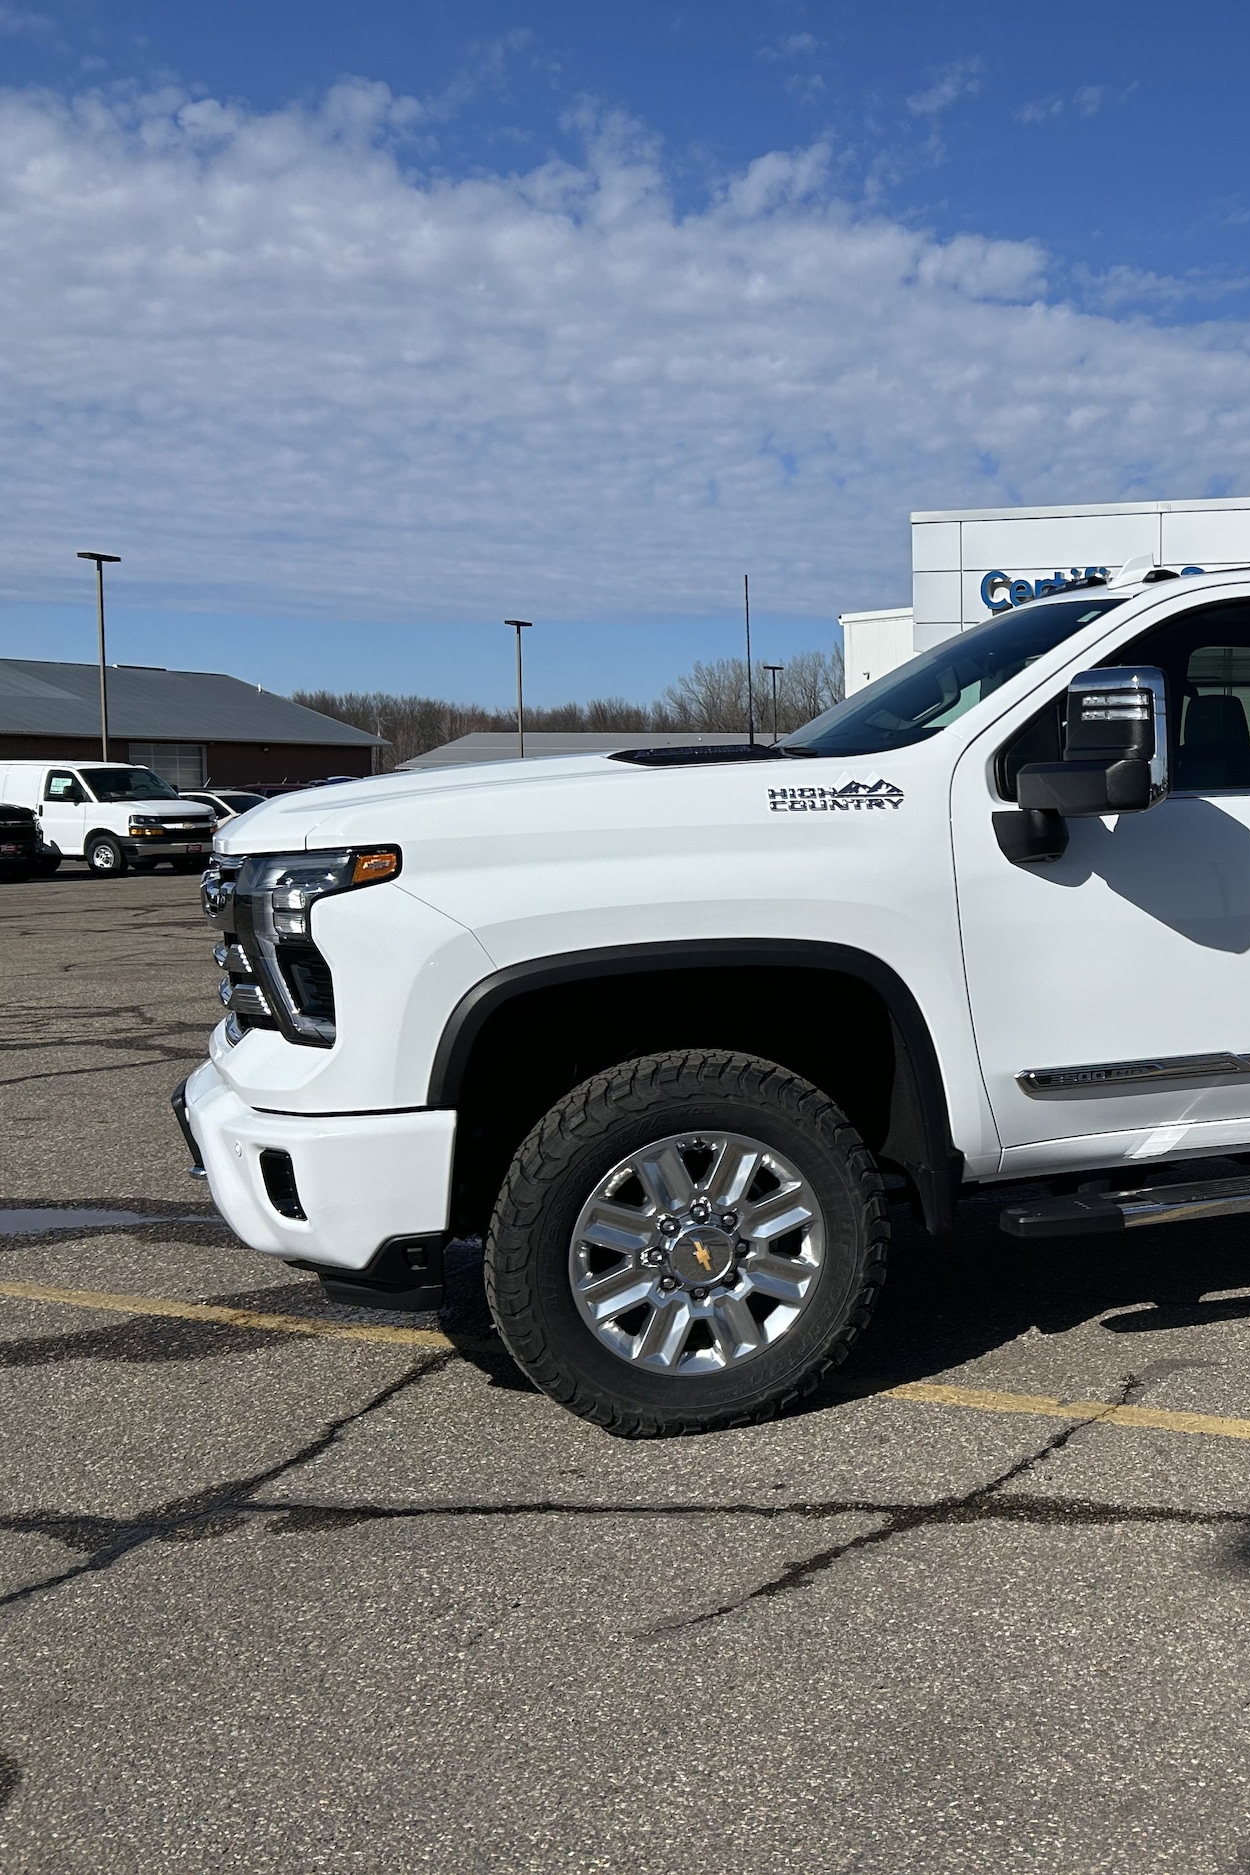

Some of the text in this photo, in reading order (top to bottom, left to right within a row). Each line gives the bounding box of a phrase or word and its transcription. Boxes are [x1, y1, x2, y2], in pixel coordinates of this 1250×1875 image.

[981, 567, 1109, 609] Cert
[767, 787, 839, 799] HIGH
[769, 798, 904, 811] COUNTRY
